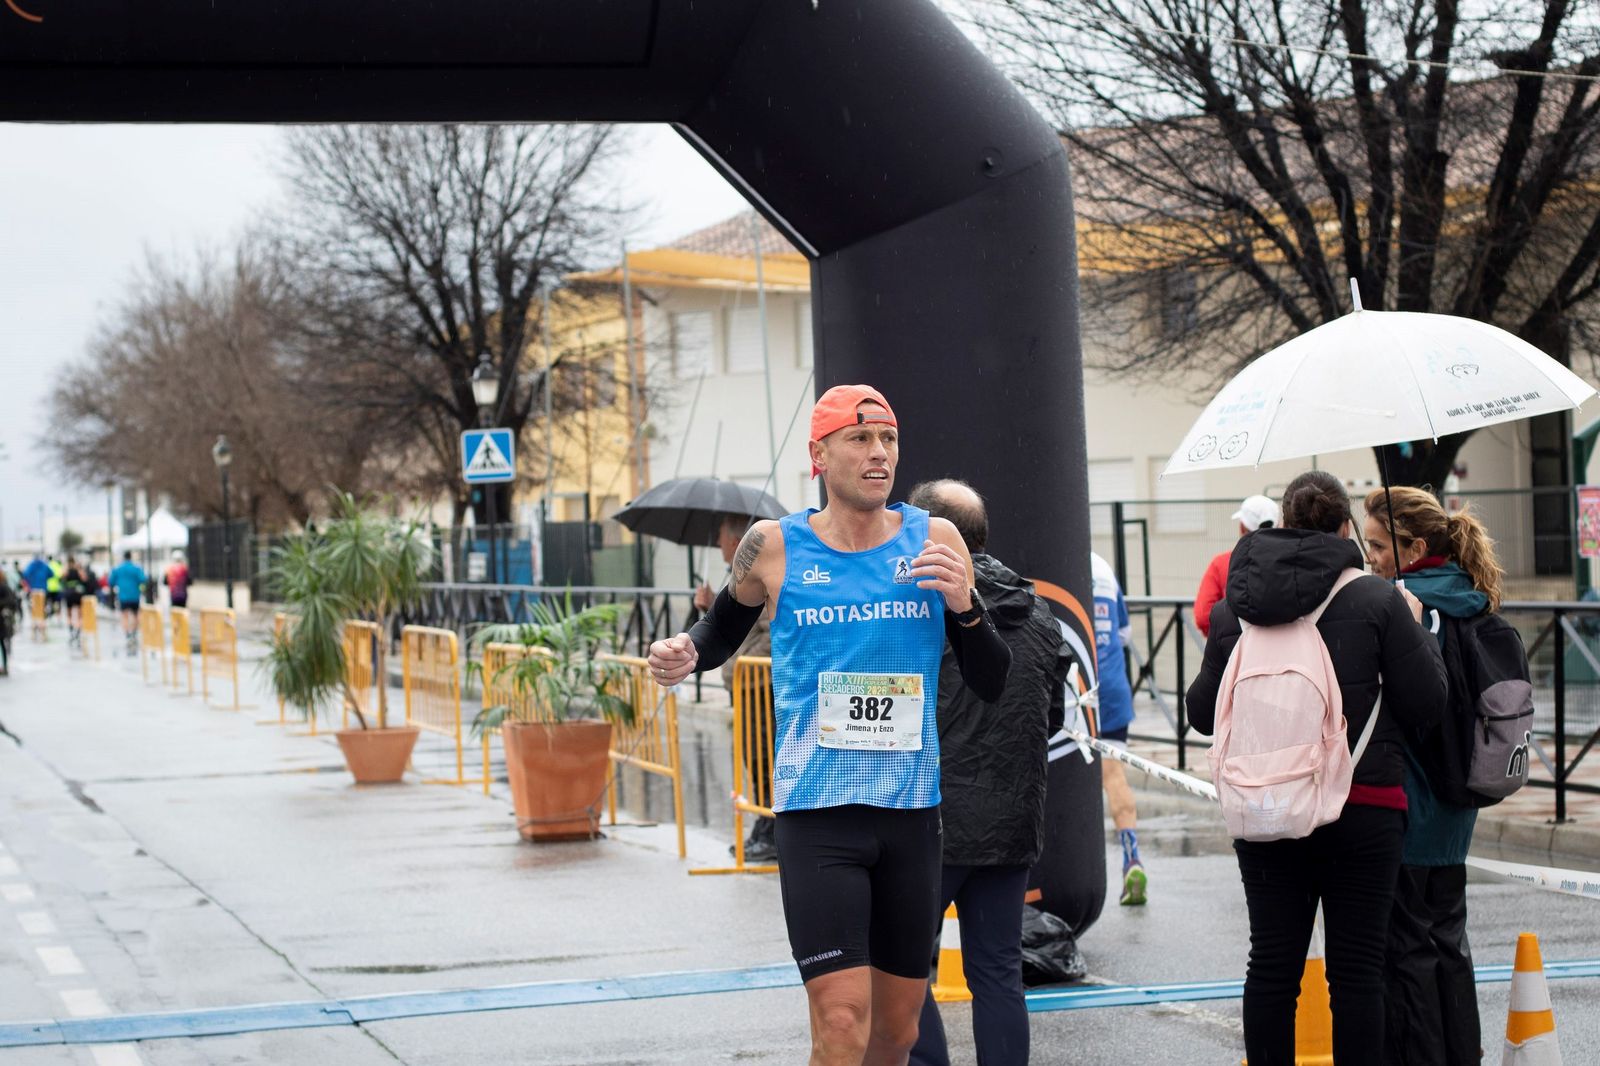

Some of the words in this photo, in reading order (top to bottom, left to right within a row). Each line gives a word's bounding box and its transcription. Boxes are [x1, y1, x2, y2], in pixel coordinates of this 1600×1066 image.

[802, 564, 831, 582] als
[793, 601, 931, 626] TROTASIERRA
[823, 674, 843, 684] RUTA
[823, 684, 865, 694] SECADEROS
[867, 685, 888, 695] 2026
[849, 696, 894, 721] 382
[845, 724, 872, 732] Jimena
